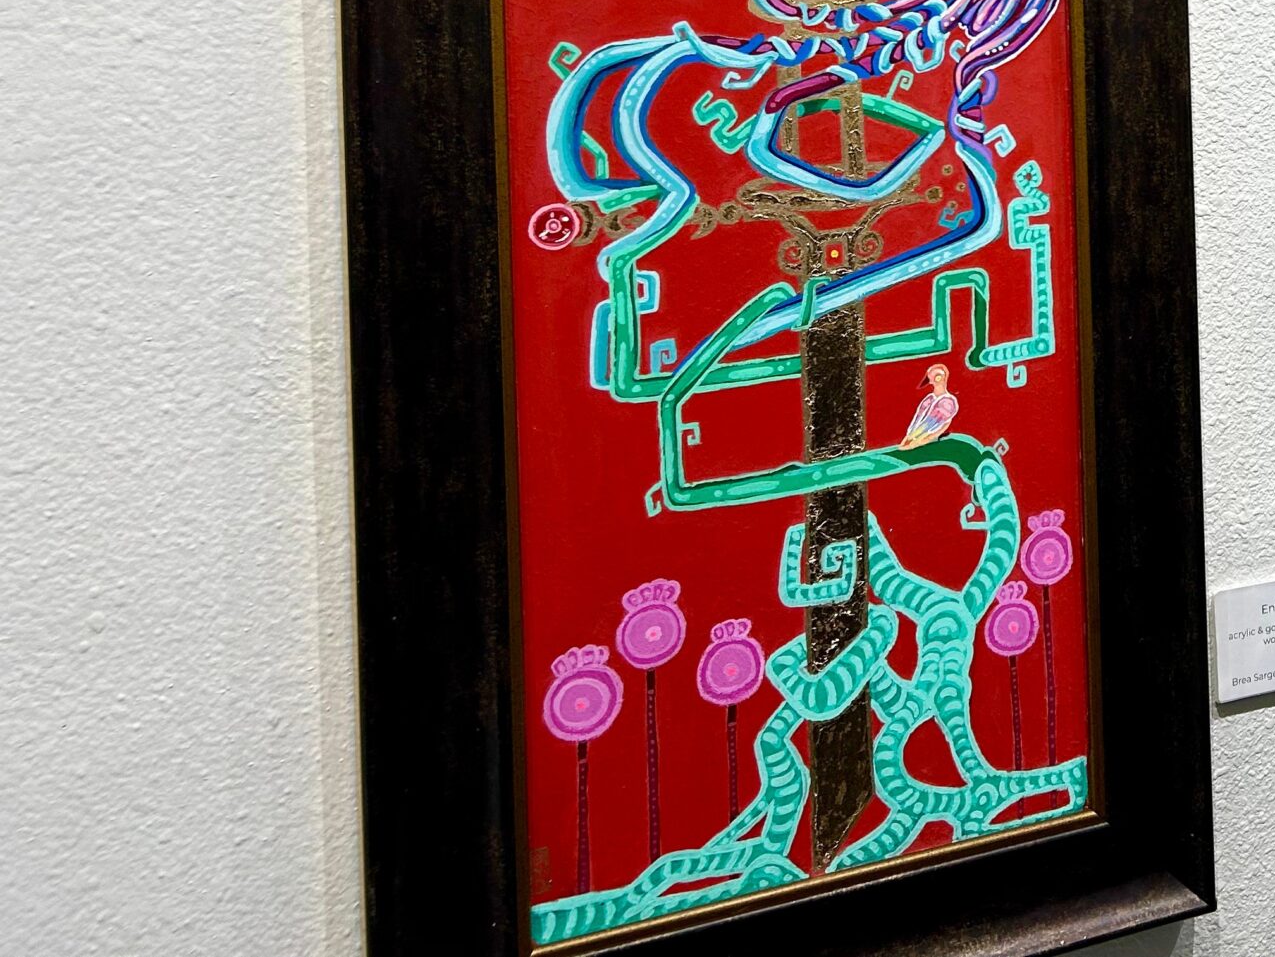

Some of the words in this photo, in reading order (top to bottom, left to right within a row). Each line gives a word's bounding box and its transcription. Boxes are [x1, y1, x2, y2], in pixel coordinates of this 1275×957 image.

[1228, 628, 1256, 641] acrylic
[1257, 625, 1264, 635] &
[1232, 675, 1252, 687] Brea
